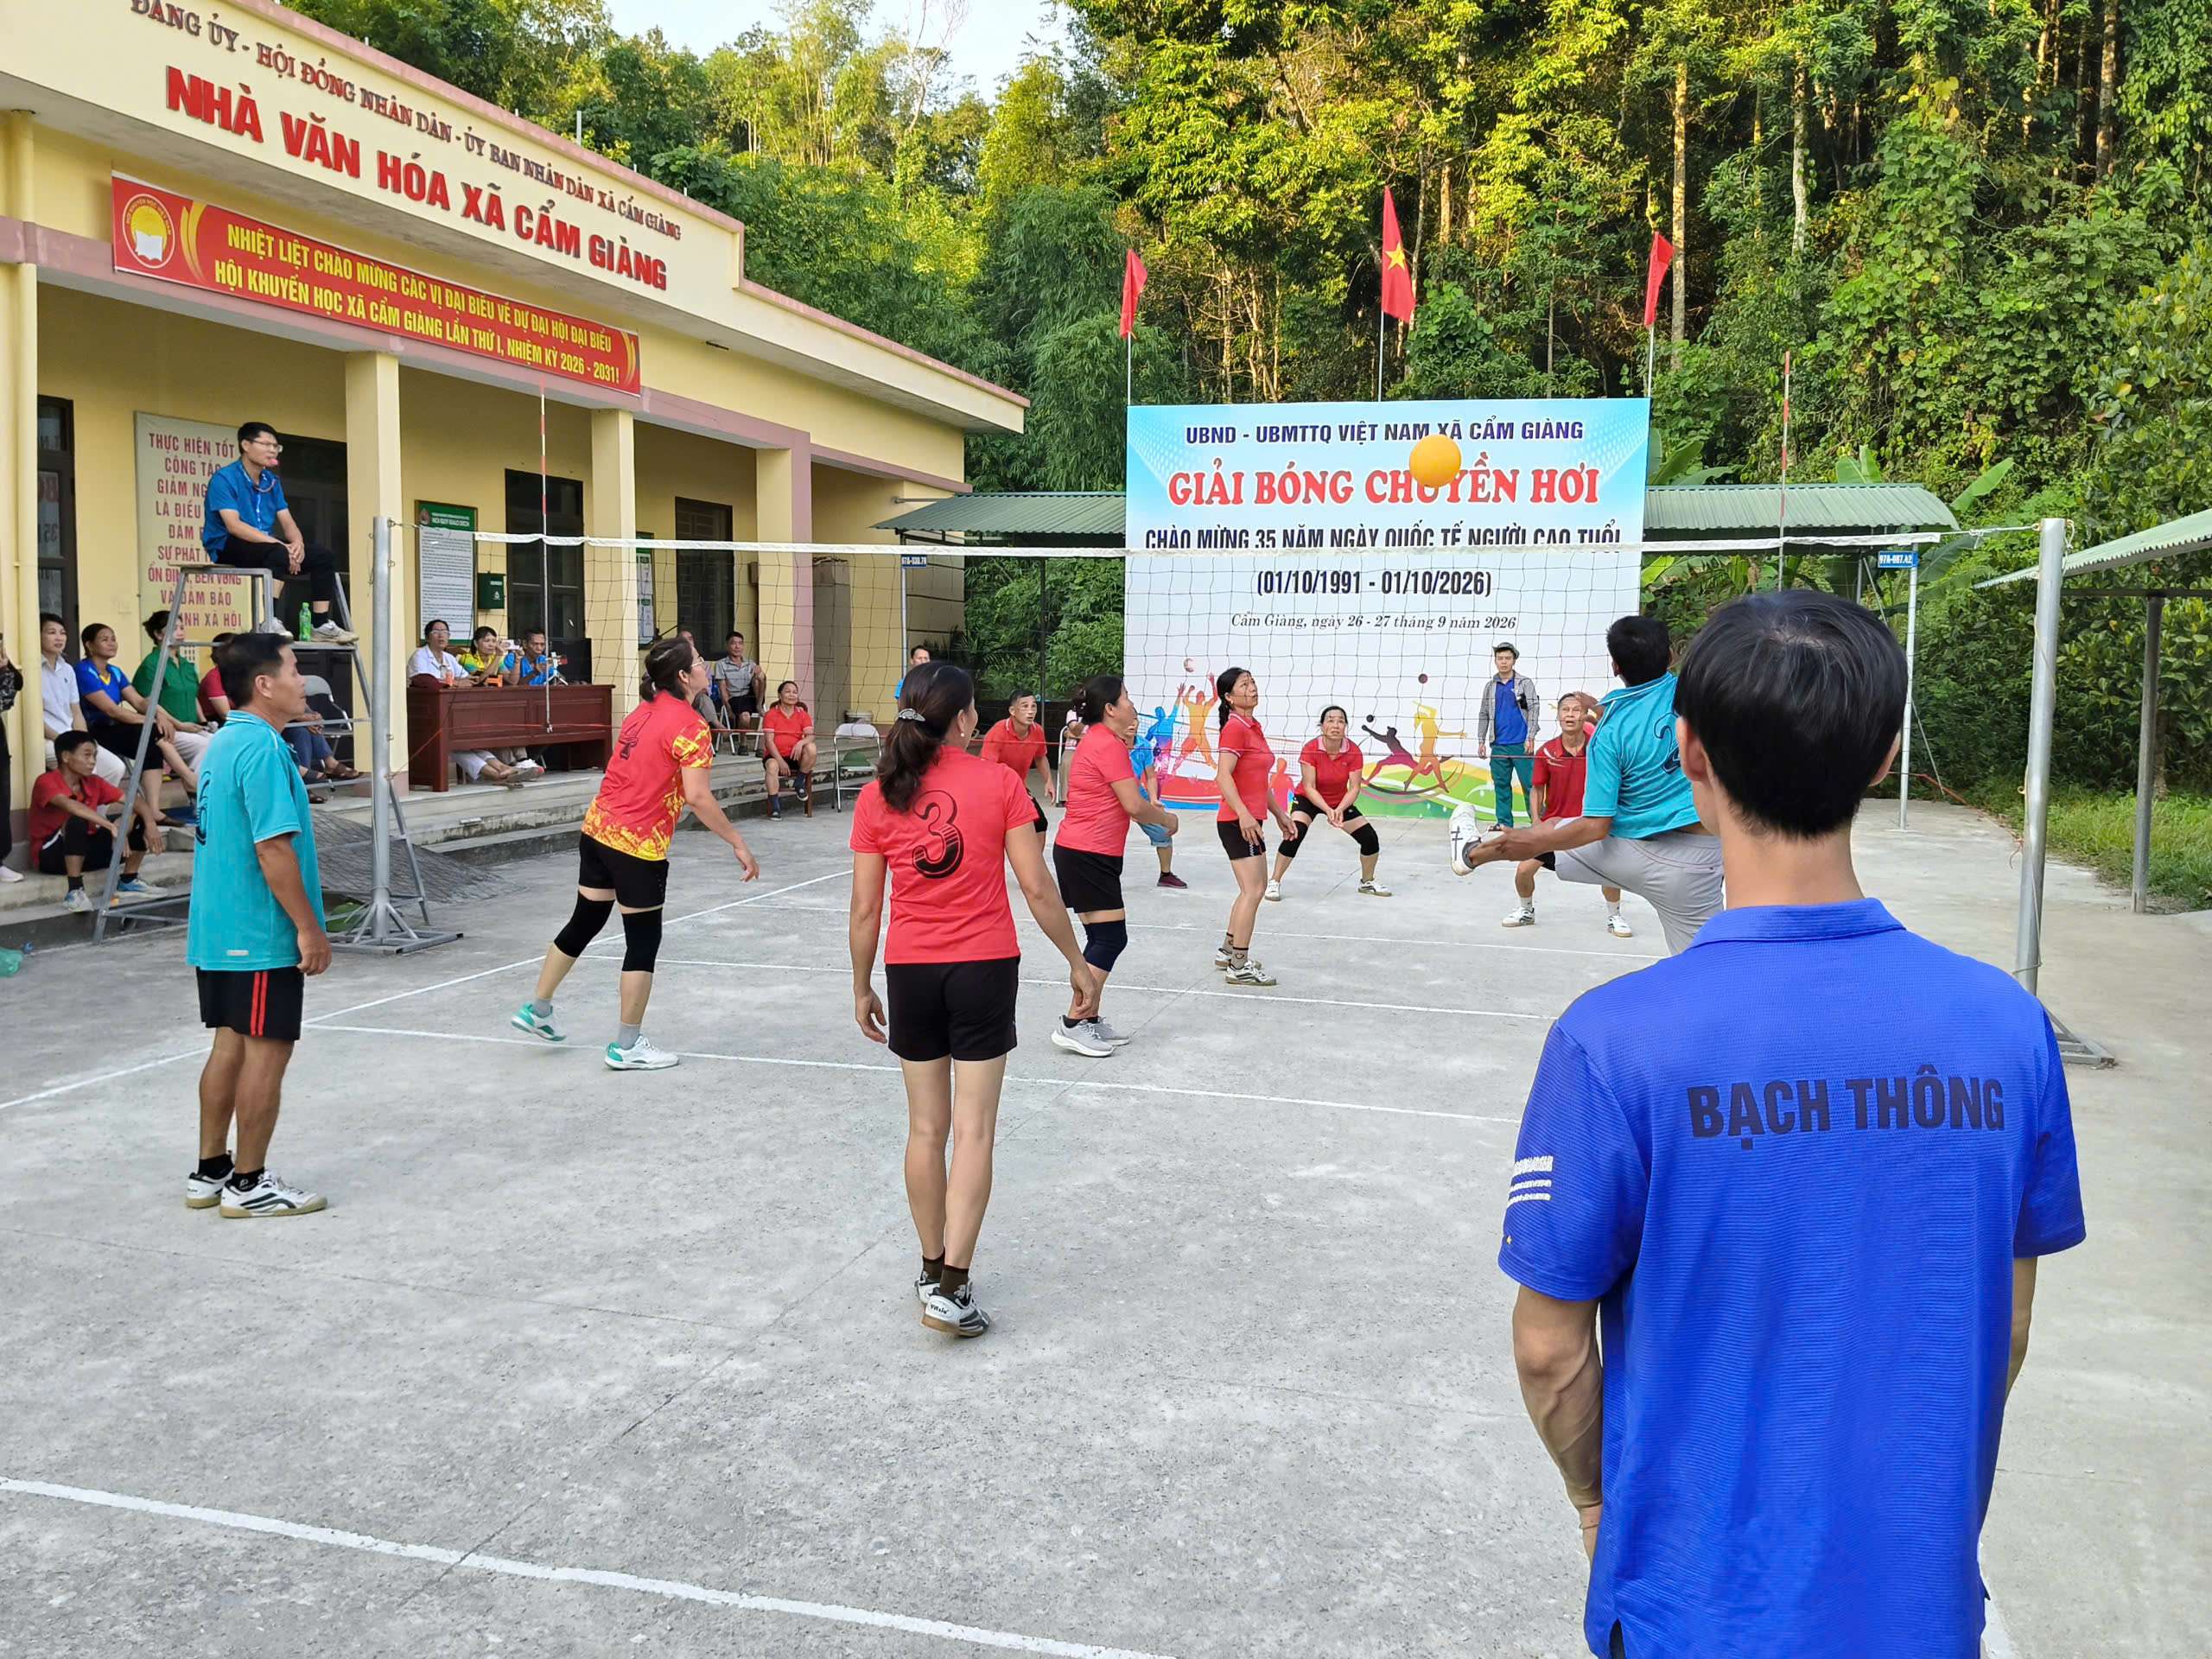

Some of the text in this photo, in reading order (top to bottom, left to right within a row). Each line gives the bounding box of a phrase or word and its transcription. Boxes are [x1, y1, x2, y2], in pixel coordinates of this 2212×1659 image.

[208, 13, 239, 52] ỦY
[257, 42, 296, 78] HỘI
[301, 58, 356, 102] ĐỒNG
[359, 87, 412, 127] NHÂN
[416, 111, 452, 143] DÂN
[464, 125, 486, 156] ỦY
[490, 143, 521, 173] BAN
[523, 157, 564, 191] NHÂN
[566, 175, 594, 203] DÂN
[597, 190, 616, 213] XÃ
[618, 195, 644, 225] CẨM
[645, 213, 681, 240] GIÀNG
[166, 65, 667, 290] NHÀ VĂN HÓA XÃ CẨM GIÀNG
[228, 223, 612, 353] NHIỆT LIỆT CHÀO MỪNG CÁC VỊ ĐẠI BIỂU VỀ DỰ ĐẠI HỘI ĐẠI BIỂU
[215, 259, 243, 291] HỘI
[248, 269, 309, 305] KHUYẾN
[314, 286, 343, 315] HỌC
[347, 294, 366, 320] XÃ
[370, 296, 400, 328] CẨM
[404, 309, 443, 340] GIÀNG
[447, 317, 469, 346] LẦN
[473, 328, 495, 352] THỨ
[498, 335, 505, 356] I,
[507, 340, 543, 365] NHIỆM
[544, 346, 559, 368] KỲ
[560, 353, 584, 376] 2026
[594, 361, 620, 384] 2031!
[1185, 426, 1236, 444] UBND
[1256, 425, 1332, 444] UBMTTQ
[1338, 420, 1378, 445] VIỆT
[1384, 423, 1429, 441] NAM
[1438, 420, 1463, 441] XÃ
[1470, 415, 1514, 440] CẨM
[1522, 418, 1584, 439] GIÀNG
[149, 433, 234, 458] THỰC HIỆN TỐT
[164, 455, 196, 475] CÔNG
[157, 475, 188, 496] GIẢM
[1168, 457, 1245, 505] GIẢI
[1254, 461, 1354, 505] BÓNG
[1530, 462, 1599, 504] HƠI
[156, 499, 169, 516] LÀ
[168, 520, 194, 539] ĐẢM
[1146, 524, 1192, 549] CHÀO
[1197, 524, 1249, 549] MỪNG
[1255, 529, 1276, 549] 35
[1282, 524, 1324, 549] NĂM
[1330, 524, 1379, 548] NGÀY
[1441, 520, 1464, 546] TẾ
[175, 544, 200, 563] PHÁT
[148, 561, 163, 583] ỔN
[1257, 570, 1361, 597] (01/10/1991
[1382, 570, 1491, 597] 01/10/2026)
[210, 586, 232, 606] BẢO
[205, 608, 219, 626] XÃ
[224, 610, 242, 631] HỘI
[1231, 611, 1261, 627] Cẩm
[1264, 613, 1307, 630] Giàng,
[1312, 615, 1344, 630] ngày
[1347, 614, 1363, 627] 26
[1374, 614, 1390, 627] 27
[1394, 614, 1435, 631] tháng
[1438, 615, 1446, 628] 9
[1450, 616, 1480, 628] năm
[1484, 616, 1516, 629] 2026
[912, 789, 964, 880] 3
[1687, 1064, 2005, 1151] BẠCH THÔNG
